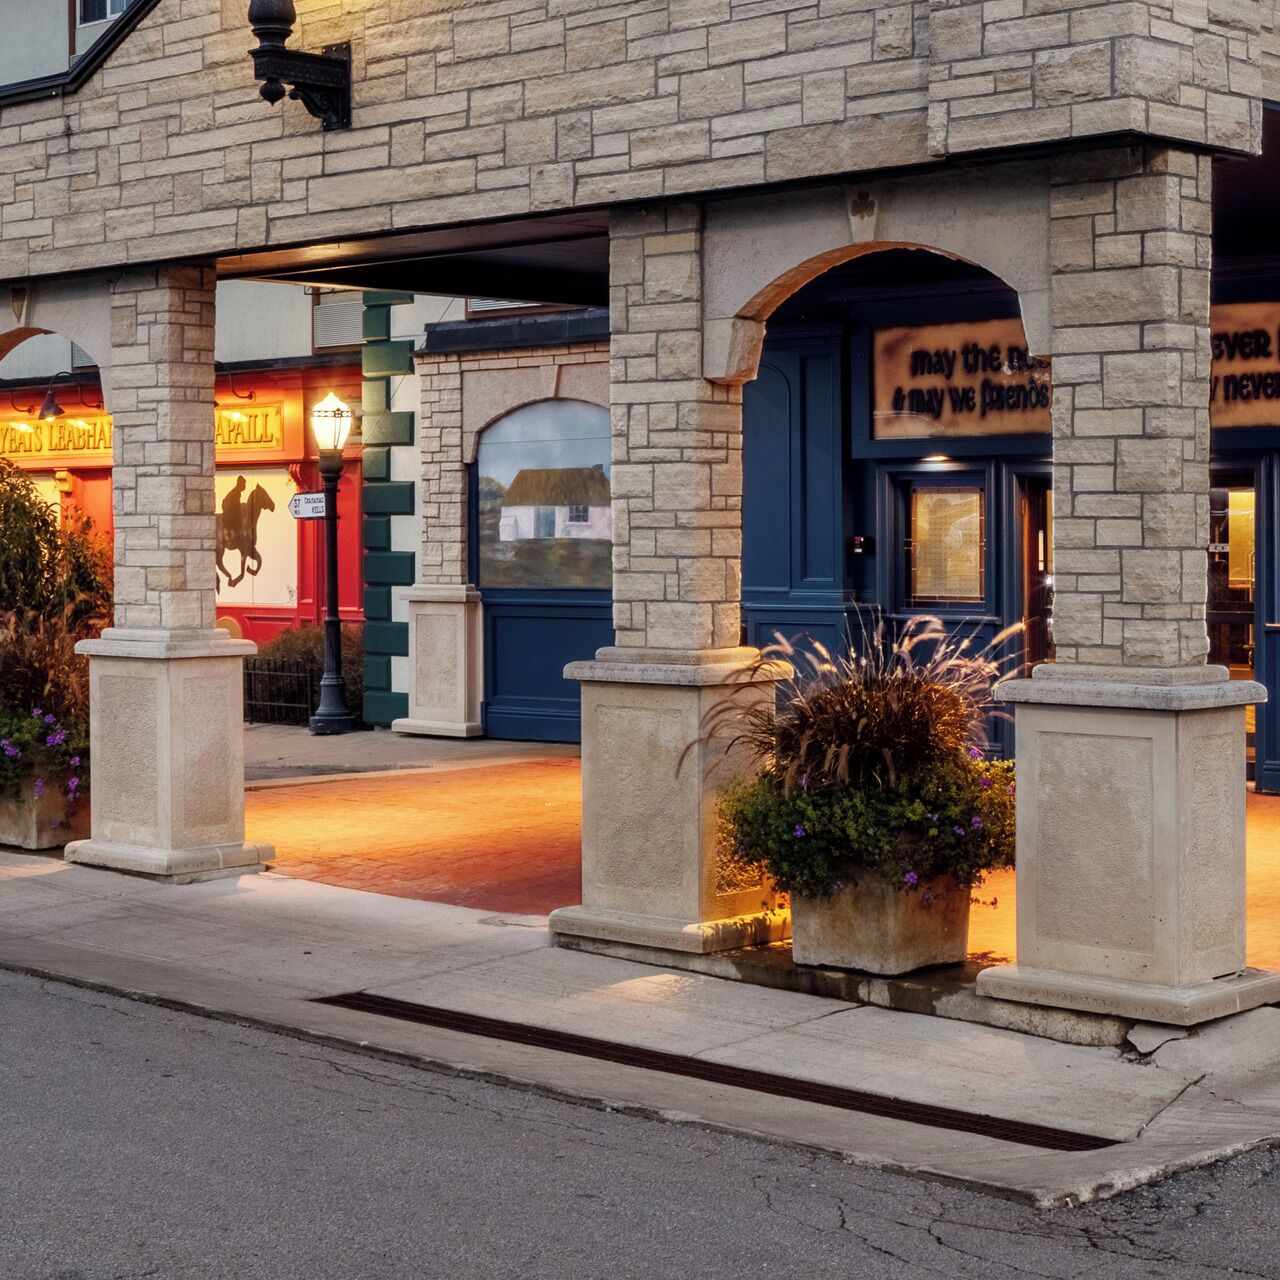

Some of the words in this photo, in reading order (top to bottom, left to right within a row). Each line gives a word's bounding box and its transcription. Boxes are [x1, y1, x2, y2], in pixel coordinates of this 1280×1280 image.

[910, 347, 957, 381] may
[961, 341, 1001, 373] the
[908, 387, 944, 419] may
[0, 425, 43, 453] YEATS
